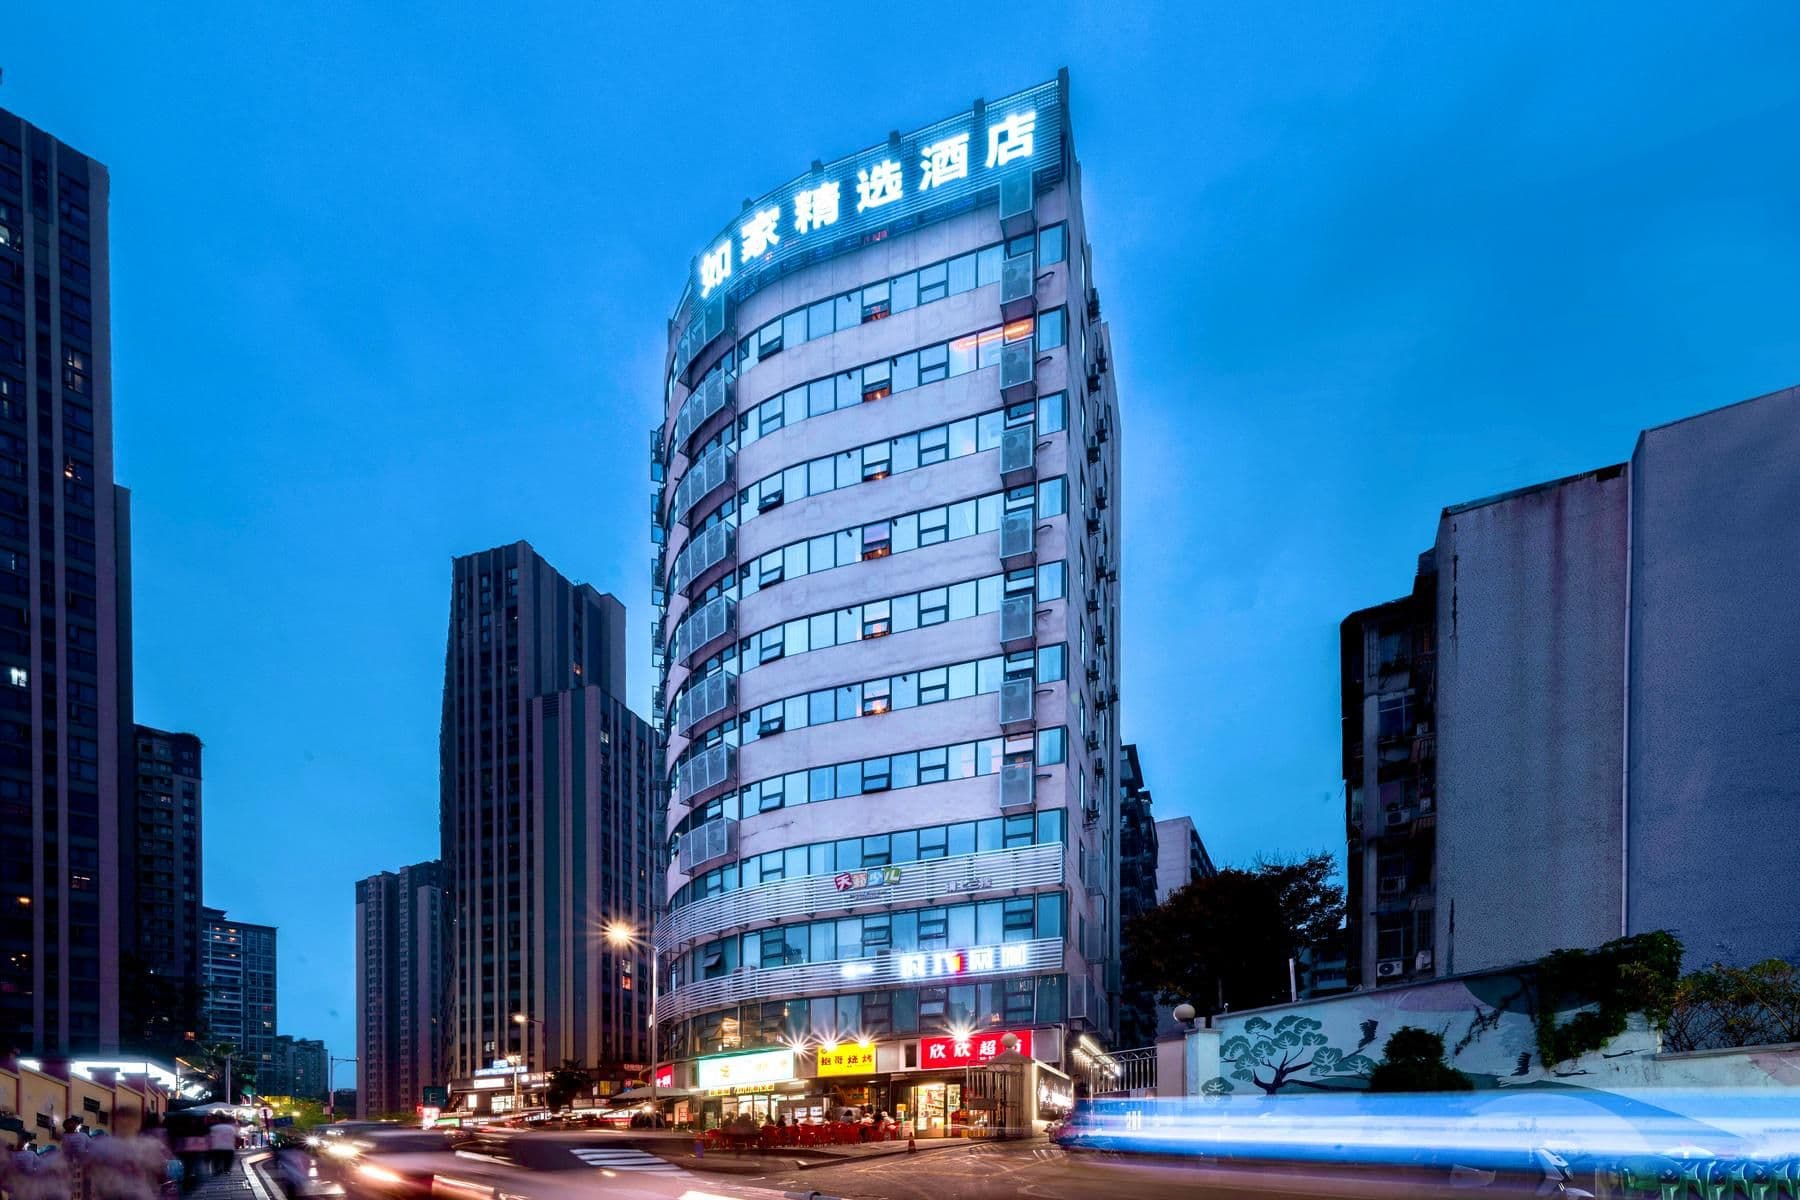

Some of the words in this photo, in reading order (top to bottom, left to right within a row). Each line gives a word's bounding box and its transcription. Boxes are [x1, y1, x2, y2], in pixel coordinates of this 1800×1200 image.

[700, 111, 1036, 298] 如家精选酒店
